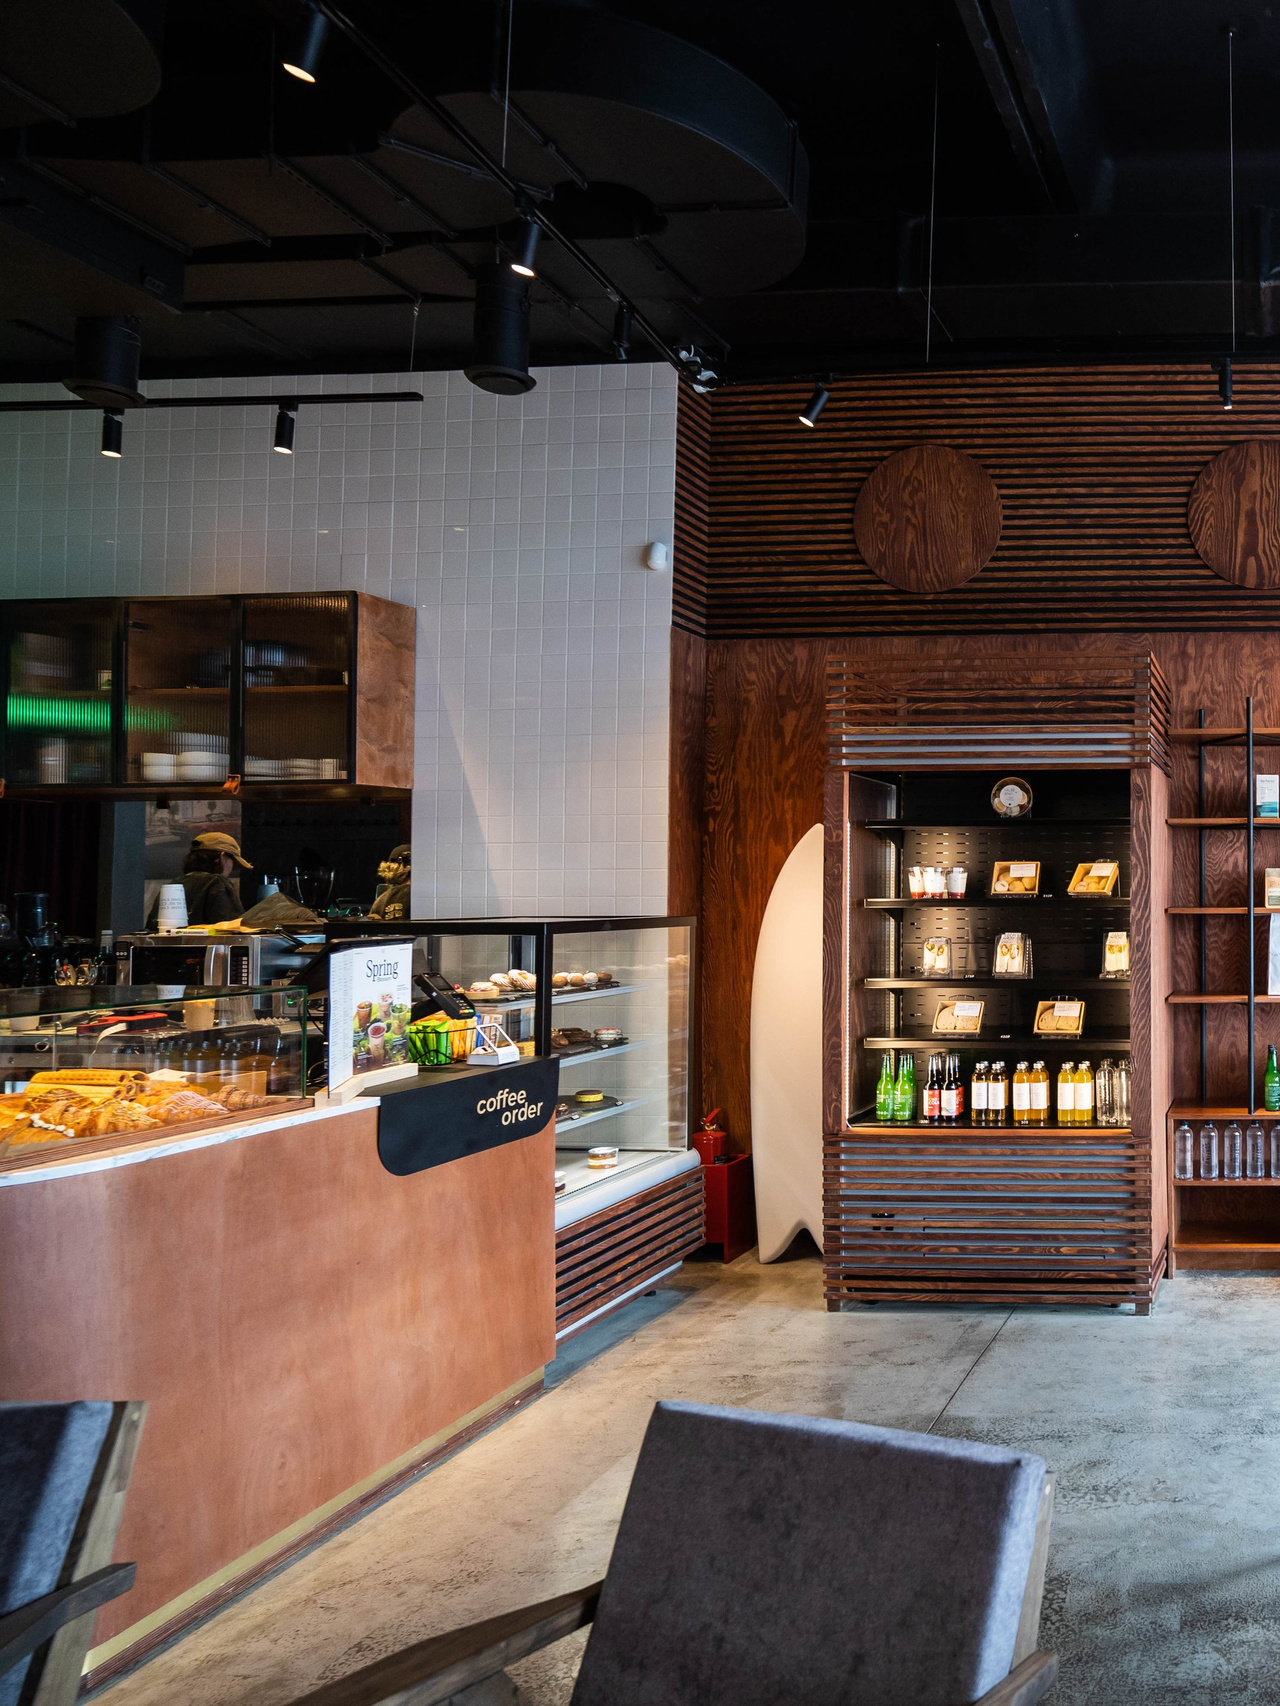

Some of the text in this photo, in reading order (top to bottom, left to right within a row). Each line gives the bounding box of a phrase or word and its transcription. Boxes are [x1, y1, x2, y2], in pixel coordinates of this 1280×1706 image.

[366, 959, 399, 982] Spring
[476, 1088, 527, 1115] coffee
[501, 1101, 544, 1126] order
